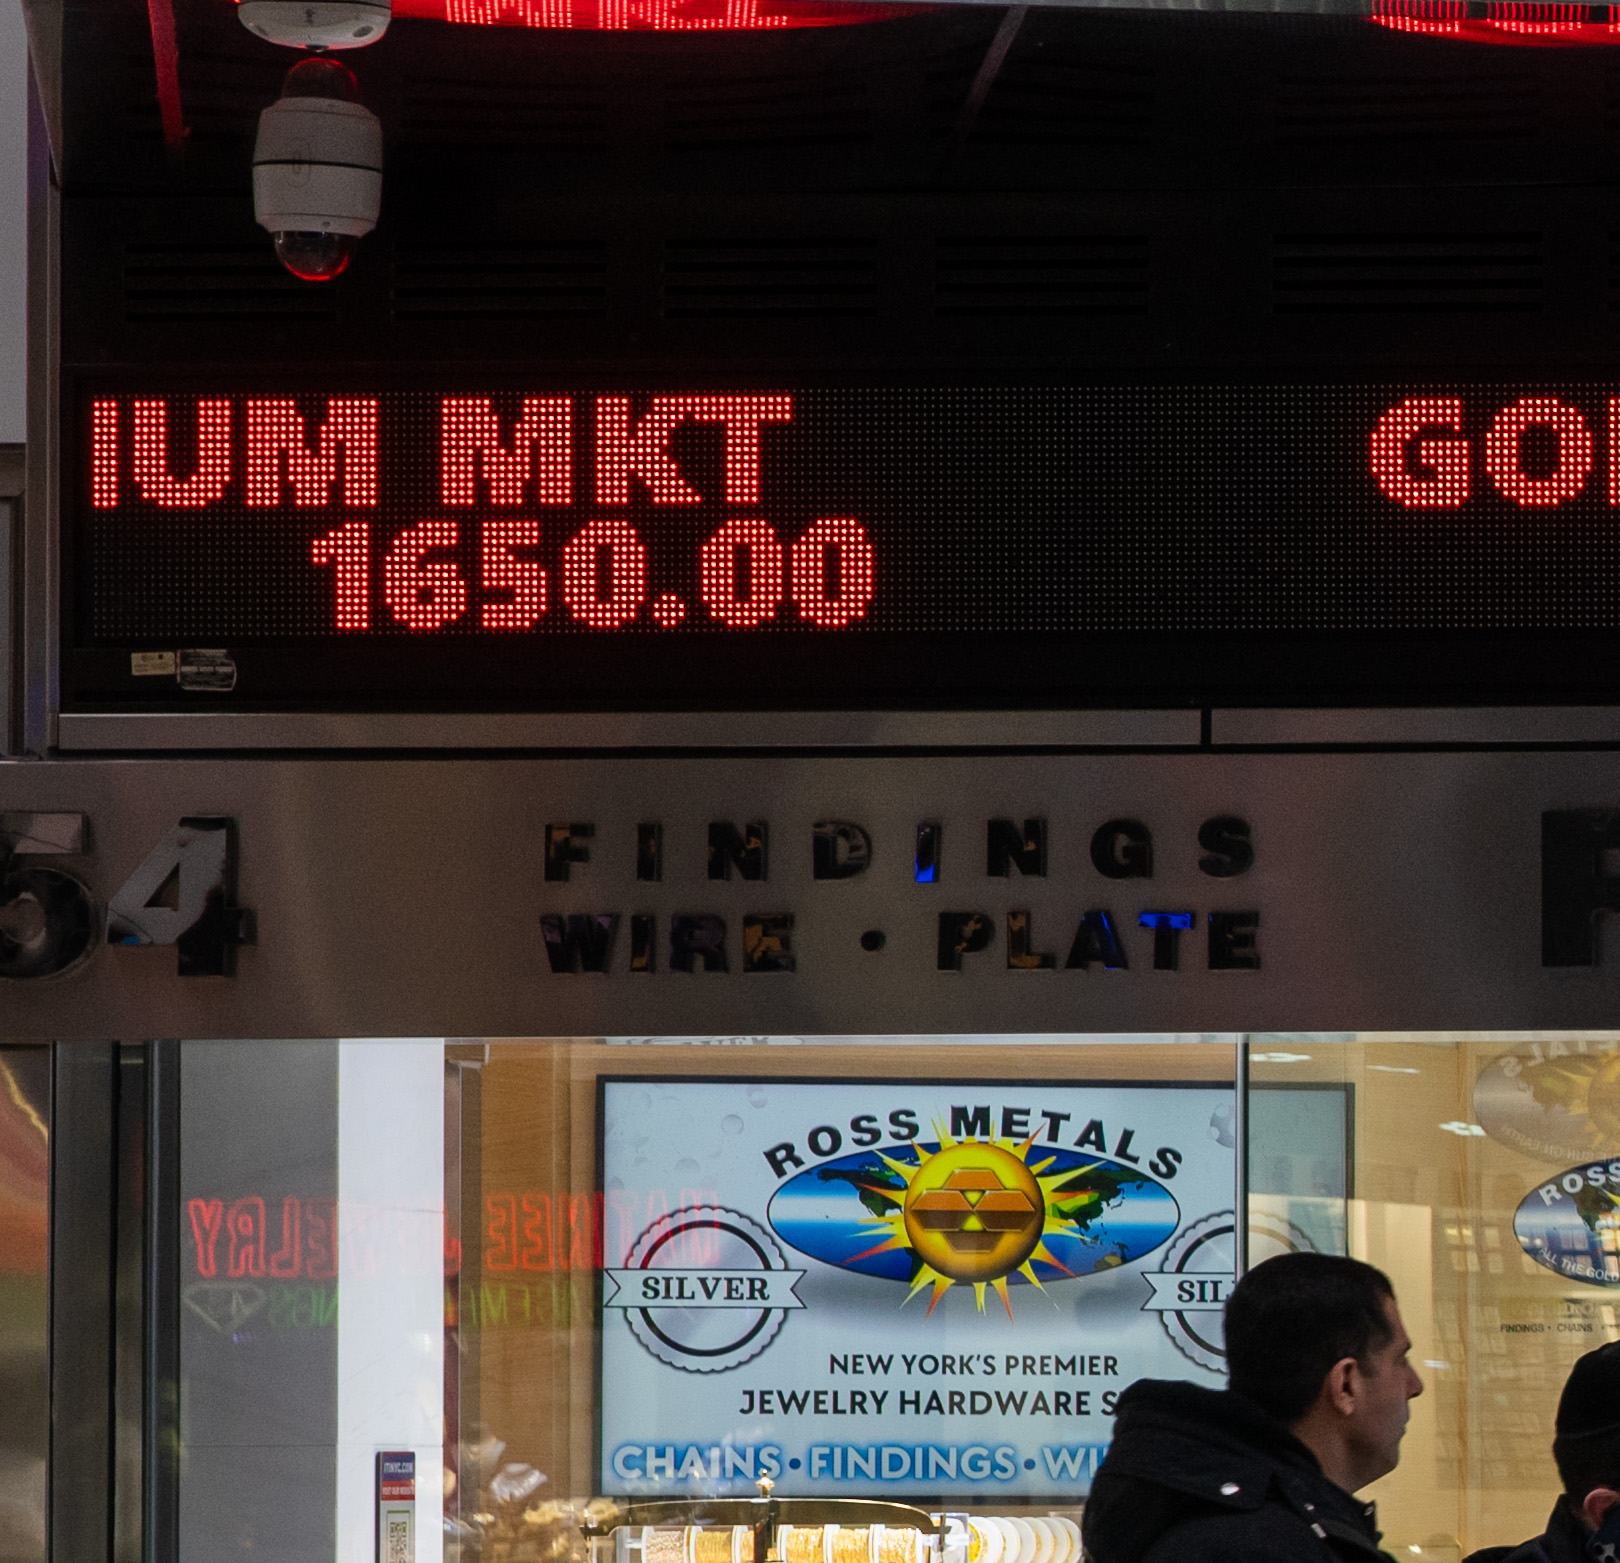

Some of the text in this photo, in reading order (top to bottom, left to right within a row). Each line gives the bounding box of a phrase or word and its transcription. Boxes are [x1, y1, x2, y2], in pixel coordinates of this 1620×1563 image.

[441, 395, 793, 506] MKT
[312, 518, 875, 630] 1650.00
[541, 813, 1260, 885] FINDINGS
[538, 905, 1263, 975] WIRE PLATE
[763, 1103, 1184, 1181] ROSS METALS
[1539, 1246, 1559, 1268] ALL
[1560, 1257, 1585, 1276] THE
[1585, 1265, 1620, 1283] GOLD
[641, 1276, 770, 1302] SILVER
[1177, 1279, 1228, 1303] SIL
[829, 1353, 1119, 1377] NEW YORK'S PREMIER
[739, 1389, 1119, 1417] JEWELRY HARDWARE S
[613, 1443, 1099, 1481] CHAINS FINDINGS WI
